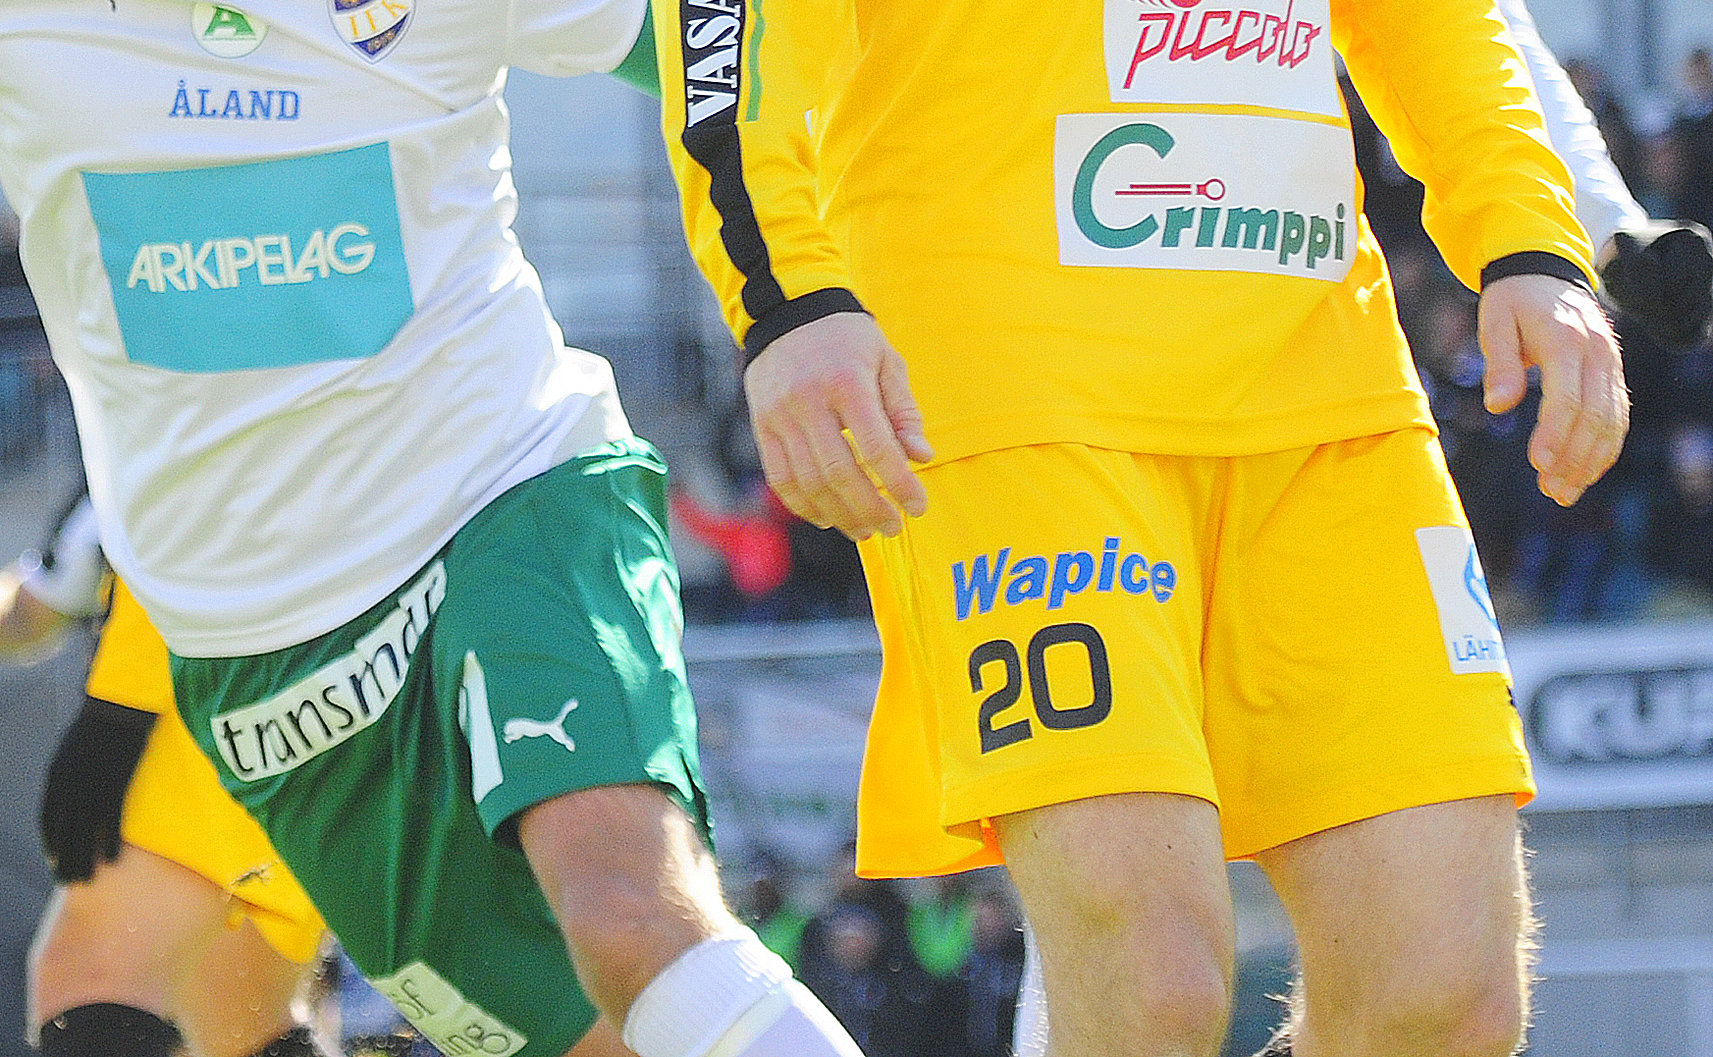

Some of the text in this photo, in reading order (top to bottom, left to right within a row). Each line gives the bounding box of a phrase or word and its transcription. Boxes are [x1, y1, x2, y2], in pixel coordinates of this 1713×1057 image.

[169, 79, 300, 120] ÅLAND
[1071, 122, 1346, 271] Crimppi
[125, 221, 376, 293] ARKIPELAG
[951, 536, 1178, 623] Wapice
[968, 621, 1114, 755] 20
